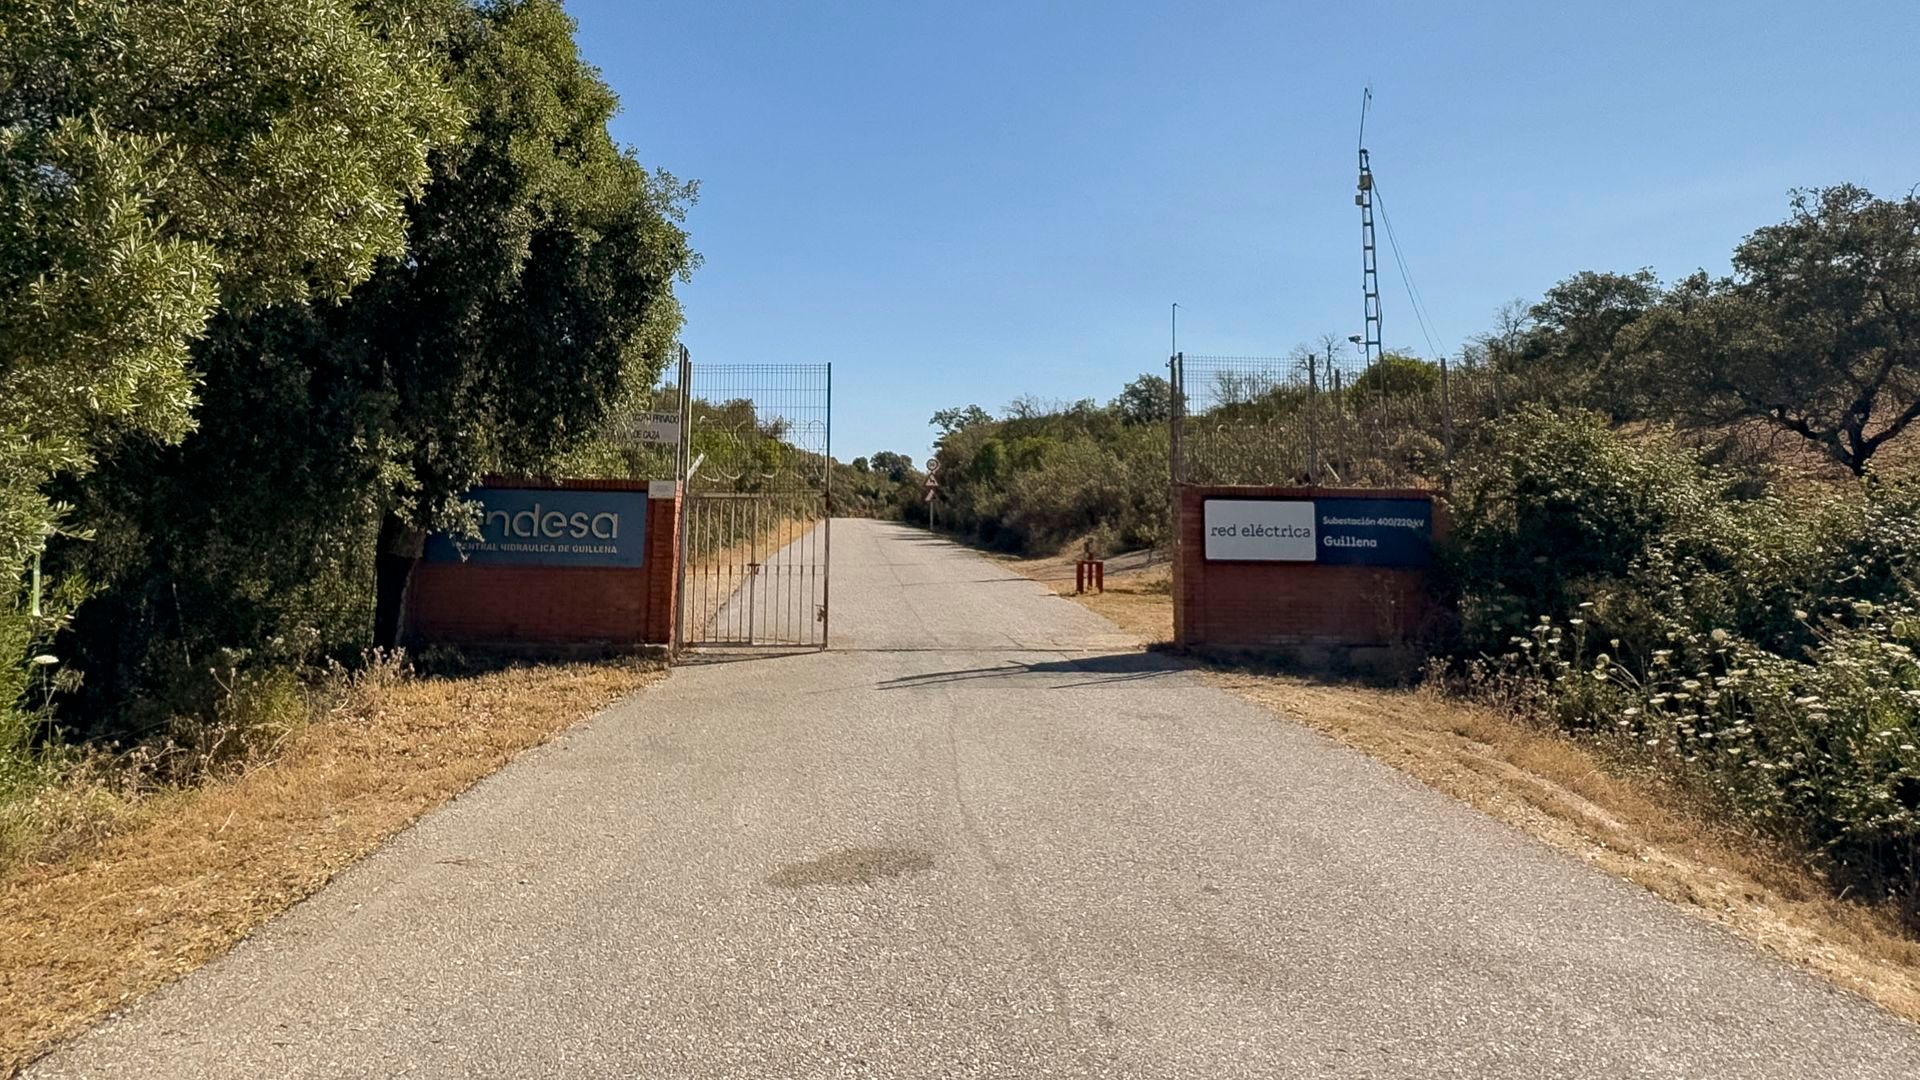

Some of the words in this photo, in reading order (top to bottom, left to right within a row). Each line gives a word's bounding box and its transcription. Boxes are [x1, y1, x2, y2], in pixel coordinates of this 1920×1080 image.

[652, 414, 679, 424] PRIVADO
[633, 430, 641, 438] DE
[643, 430, 660, 439] CAZA
[476, 504, 619, 539] ndesa
[1322, 515, 1376, 526] Subestación
[1210, 524, 1236, 537] red
[1241, 523, 1310, 538] eléctrica
[1323, 536, 1377, 548] Guillena
[558, 543, 571, 554] DE
[572, 544, 618, 554] GUILLENA
